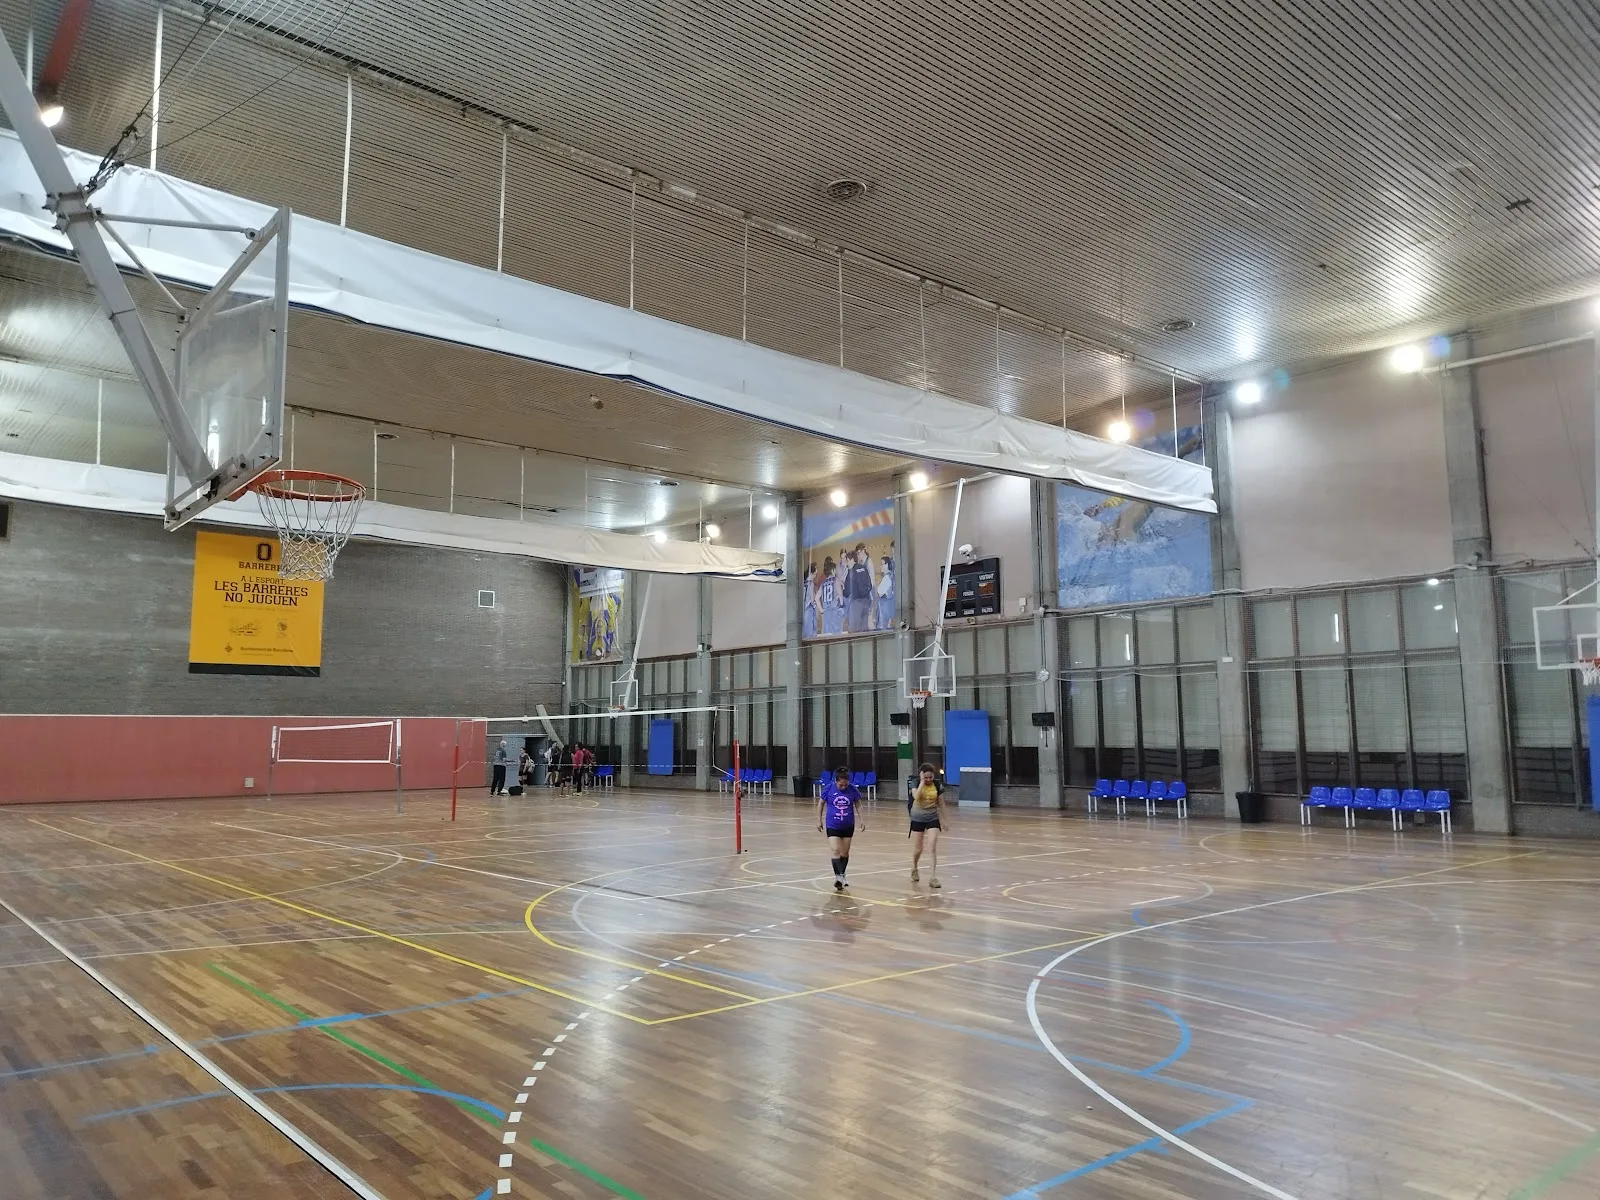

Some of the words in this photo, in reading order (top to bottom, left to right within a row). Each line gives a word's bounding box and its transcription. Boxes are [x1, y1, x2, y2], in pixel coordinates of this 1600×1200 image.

[238, 561, 291, 572] BARRER
[240, 575, 247, 583] A
[214, 580, 239, 592] LES
[243, 582, 308, 597] BARRERES
[224, 592, 243, 603] NO
[248, 593, 298, 606] JUGUEN
